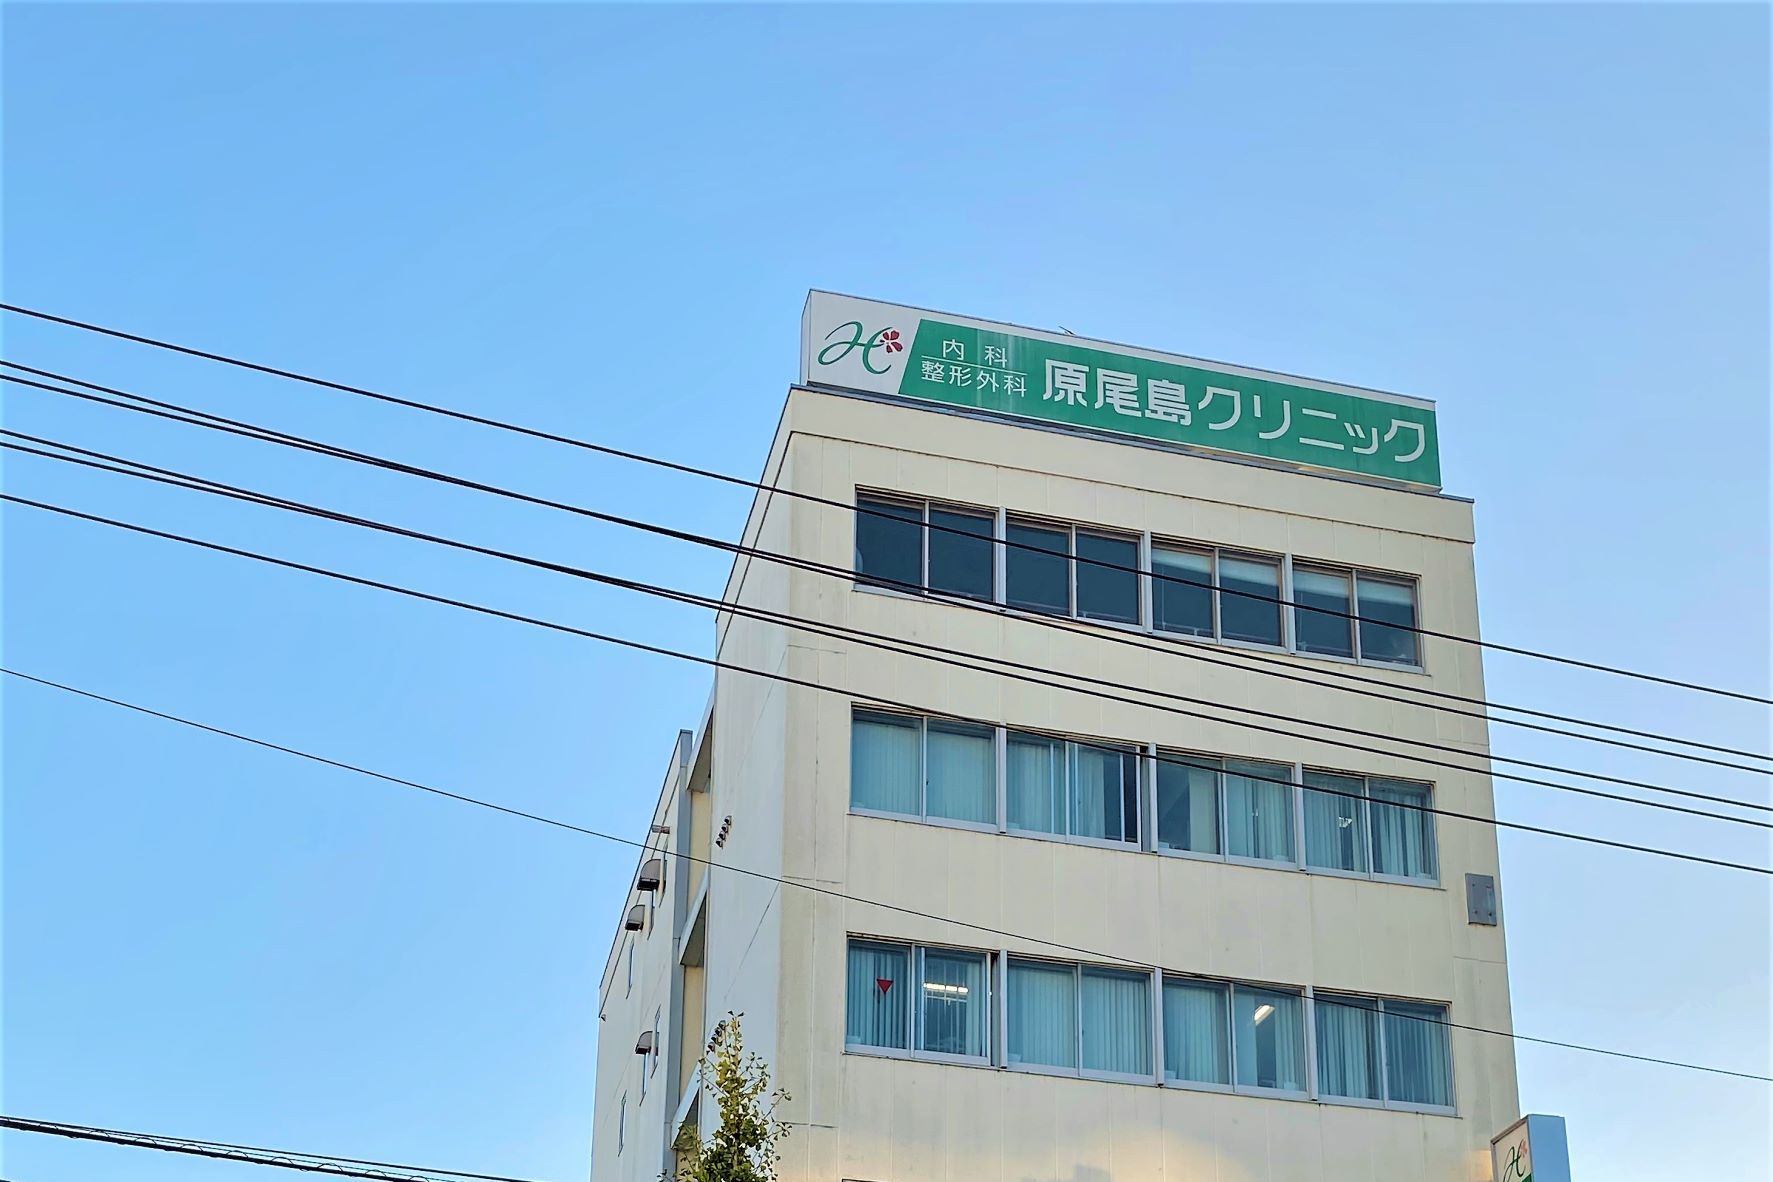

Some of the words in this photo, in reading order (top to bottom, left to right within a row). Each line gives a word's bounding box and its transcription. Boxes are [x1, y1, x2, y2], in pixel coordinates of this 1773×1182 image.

[943, 339, 1007, 368] 内科
[921, 360, 1027, 397] 整形外科
[1044, 358, 1427, 463] 原尾島クリニック
